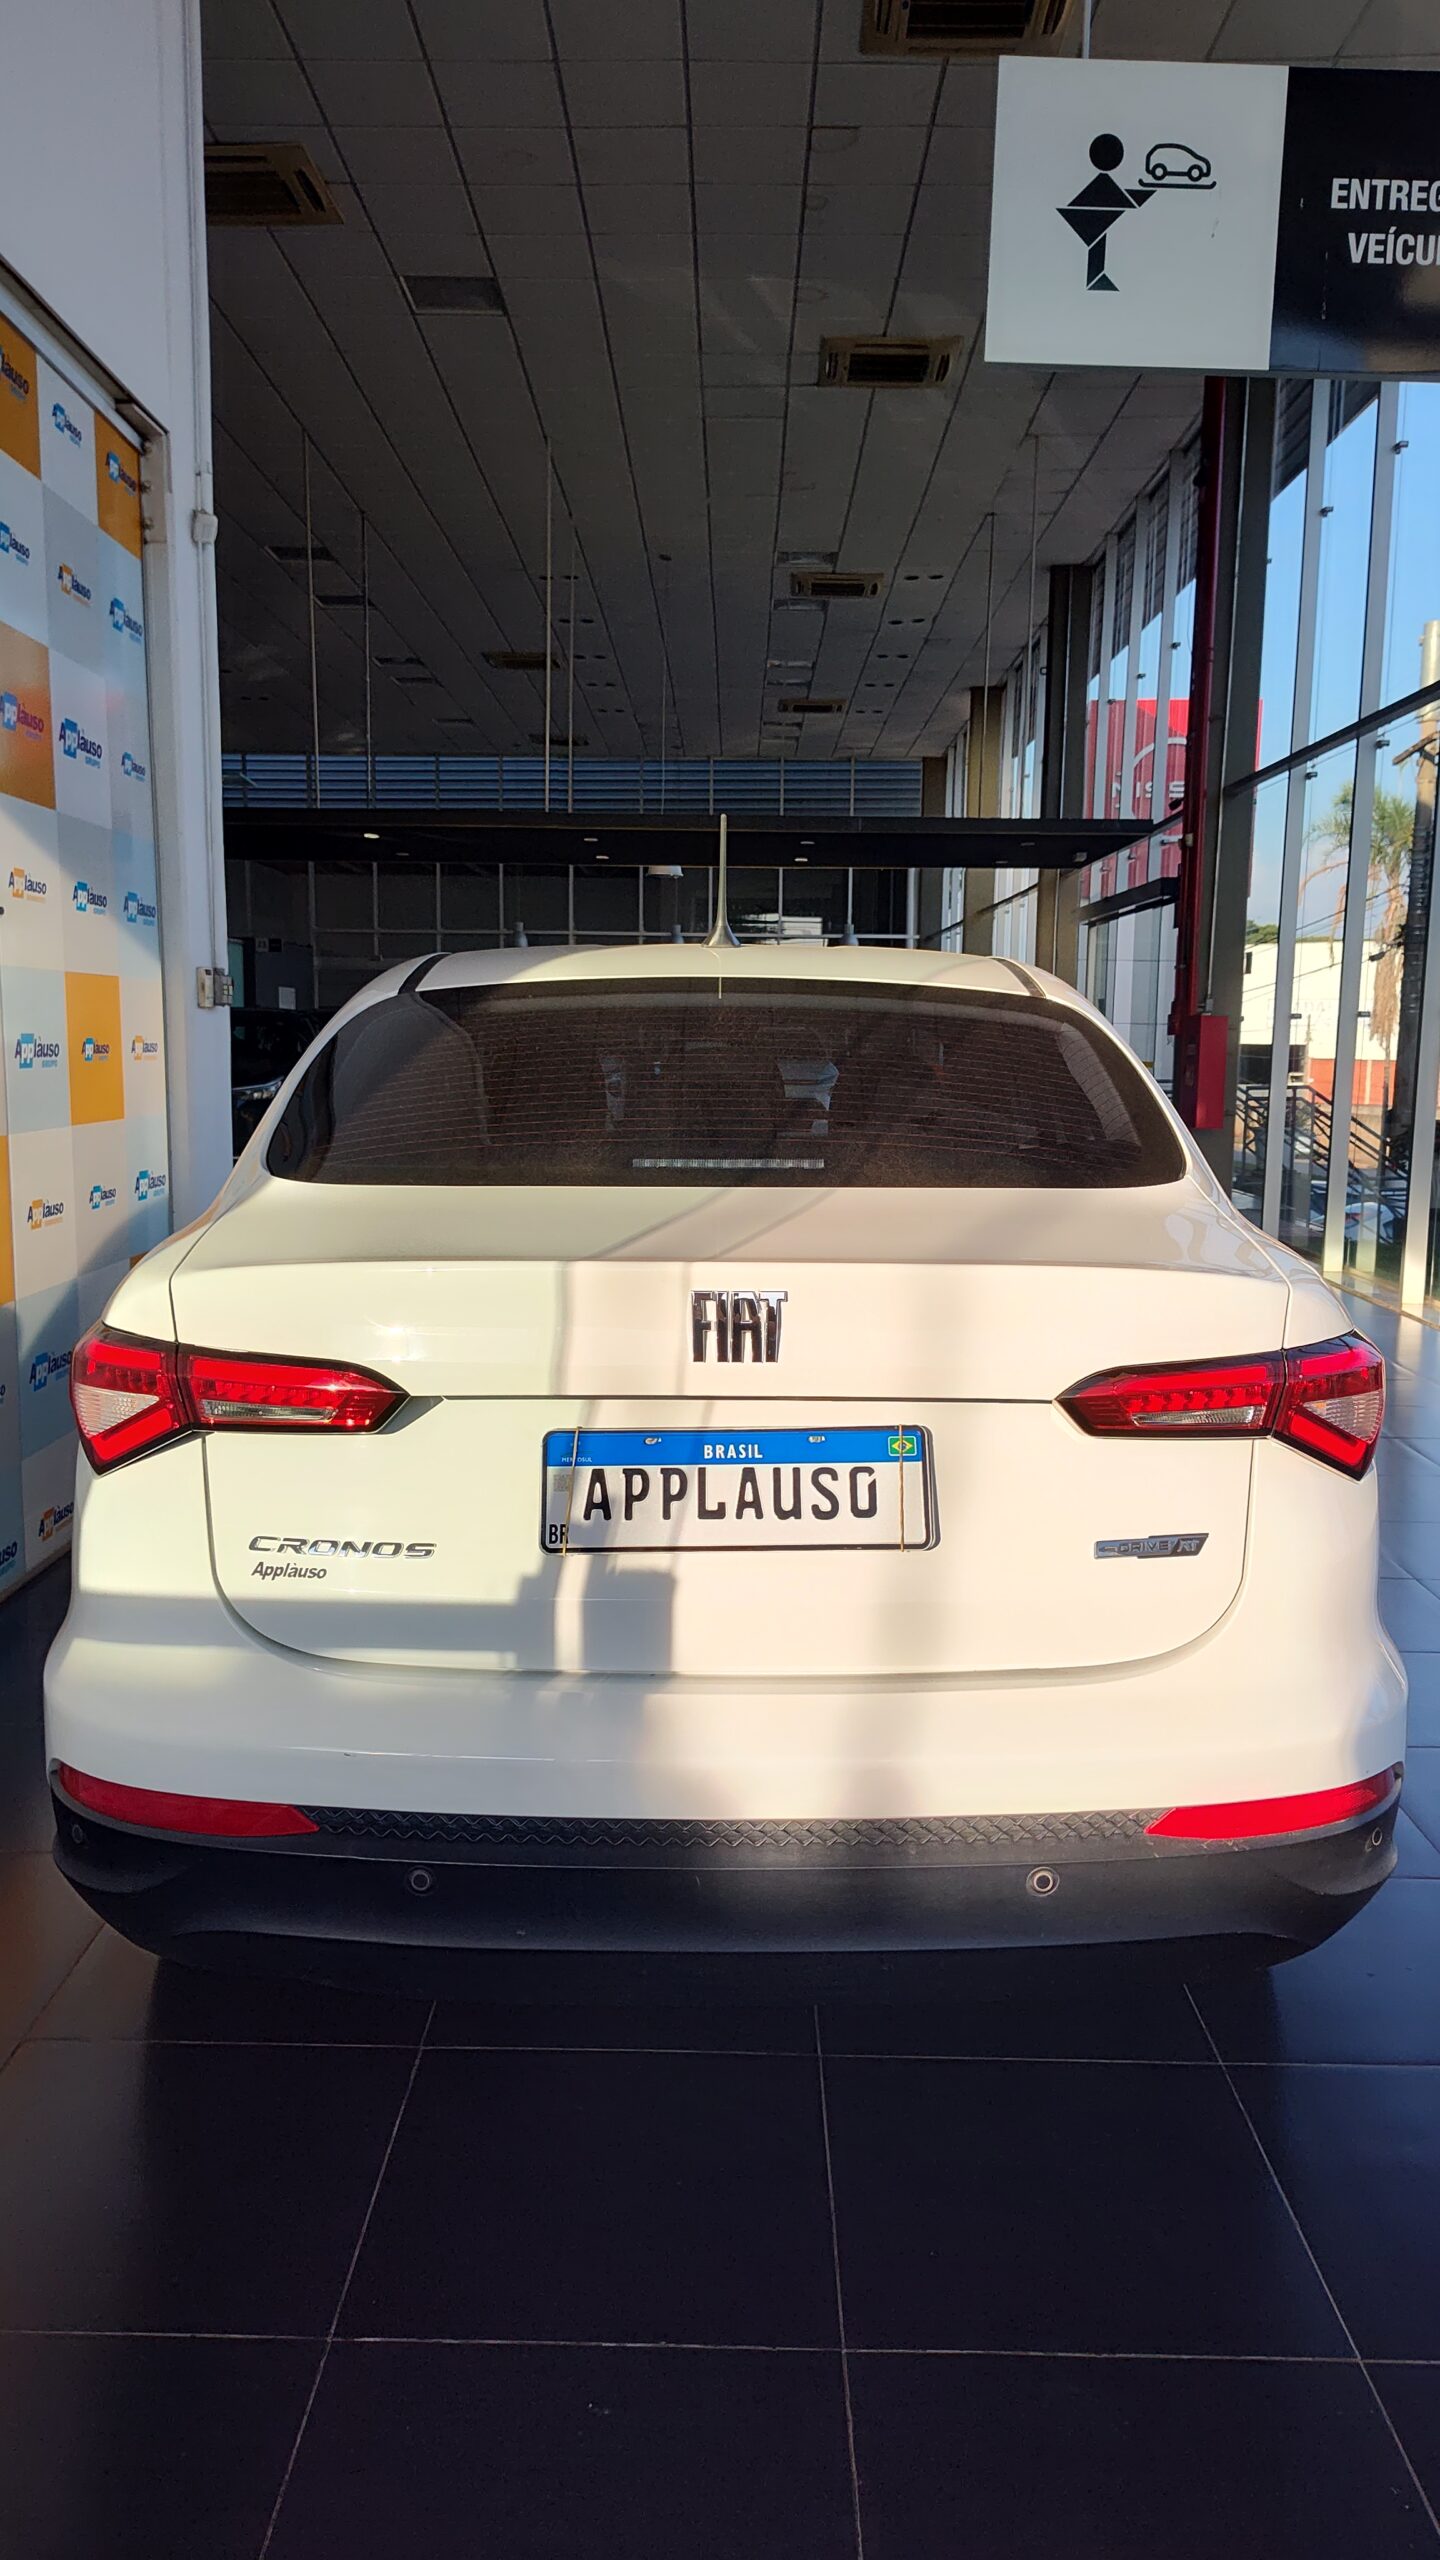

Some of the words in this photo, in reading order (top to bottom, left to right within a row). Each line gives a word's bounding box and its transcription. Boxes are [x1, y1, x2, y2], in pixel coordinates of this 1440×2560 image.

[692, 1290, 788, 1362] FIAT
[704, 1444, 763, 1459] BRASIL
[583, 1466, 878, 1521] APPLAUSO
[248, 1535, 437, 1560] CRONOS
